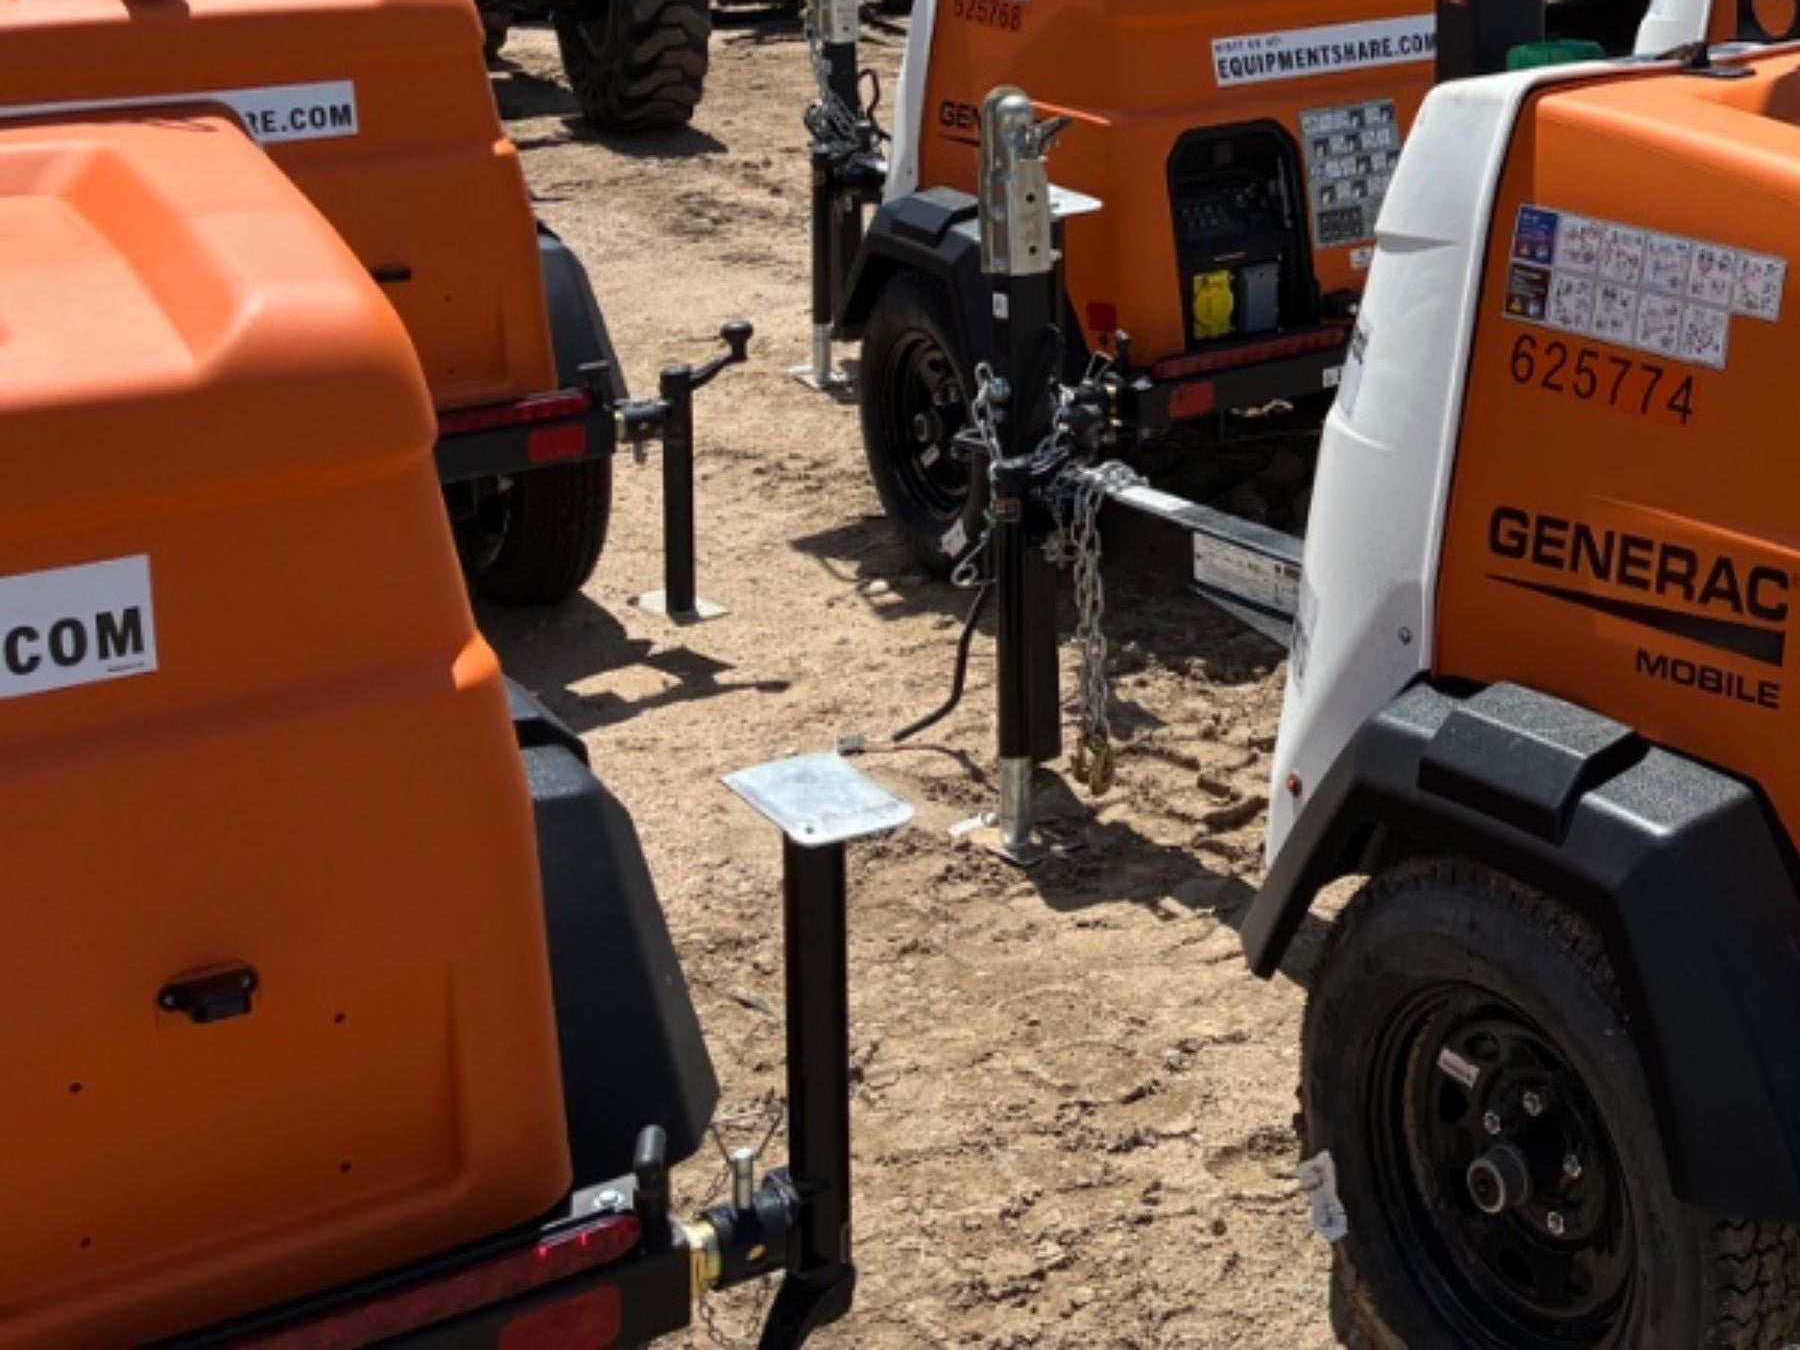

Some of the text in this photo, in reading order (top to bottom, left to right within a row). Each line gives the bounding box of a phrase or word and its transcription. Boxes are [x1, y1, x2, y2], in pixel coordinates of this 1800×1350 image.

[1511, 333, 1694, 426] 625774
[1488, 505, 1790, 623] GENERAC
[1635, 647, 1781, 711] MOBILE
